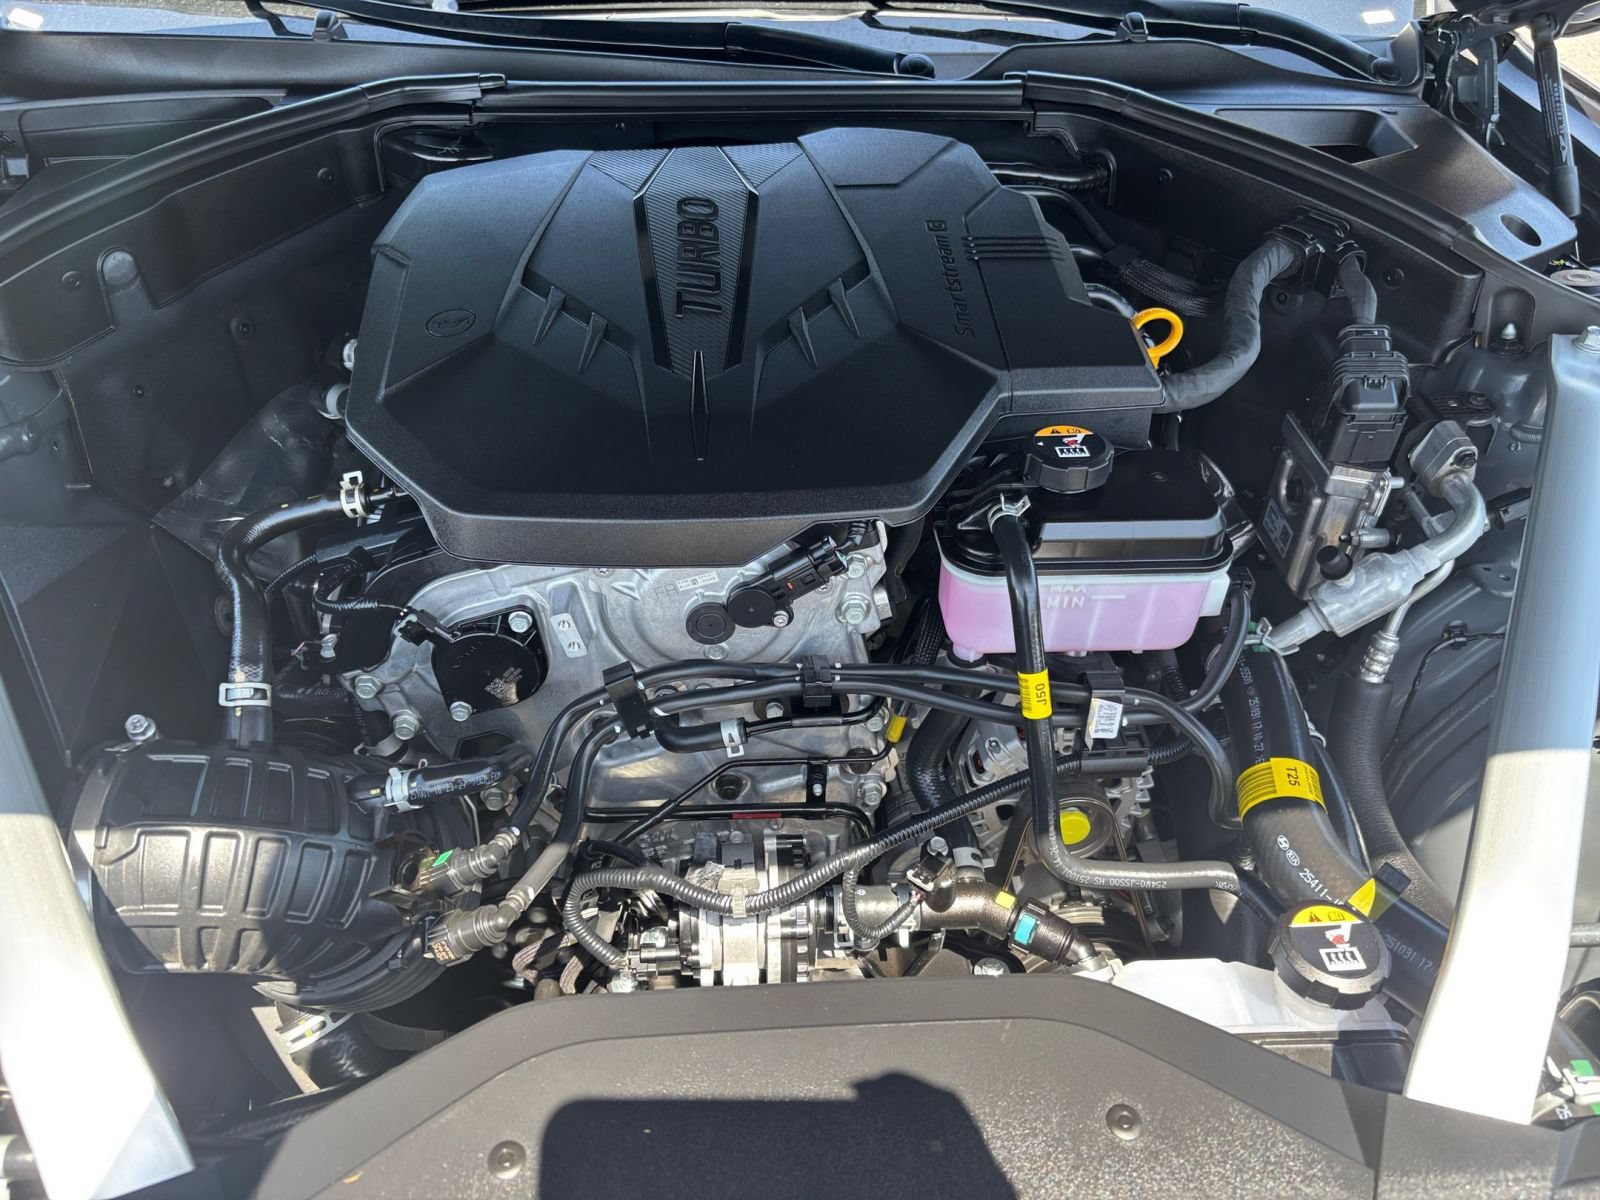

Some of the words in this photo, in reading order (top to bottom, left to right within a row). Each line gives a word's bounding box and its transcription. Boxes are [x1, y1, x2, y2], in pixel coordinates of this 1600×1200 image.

[676, 196, 722, 318] TURBO
[934, 235, 975, 338] Smartstream
[1047, 595, 1085, 608] MIN
[1035, 683, 1047, 706] J50
[1286, 765, 1299, 788] T25
